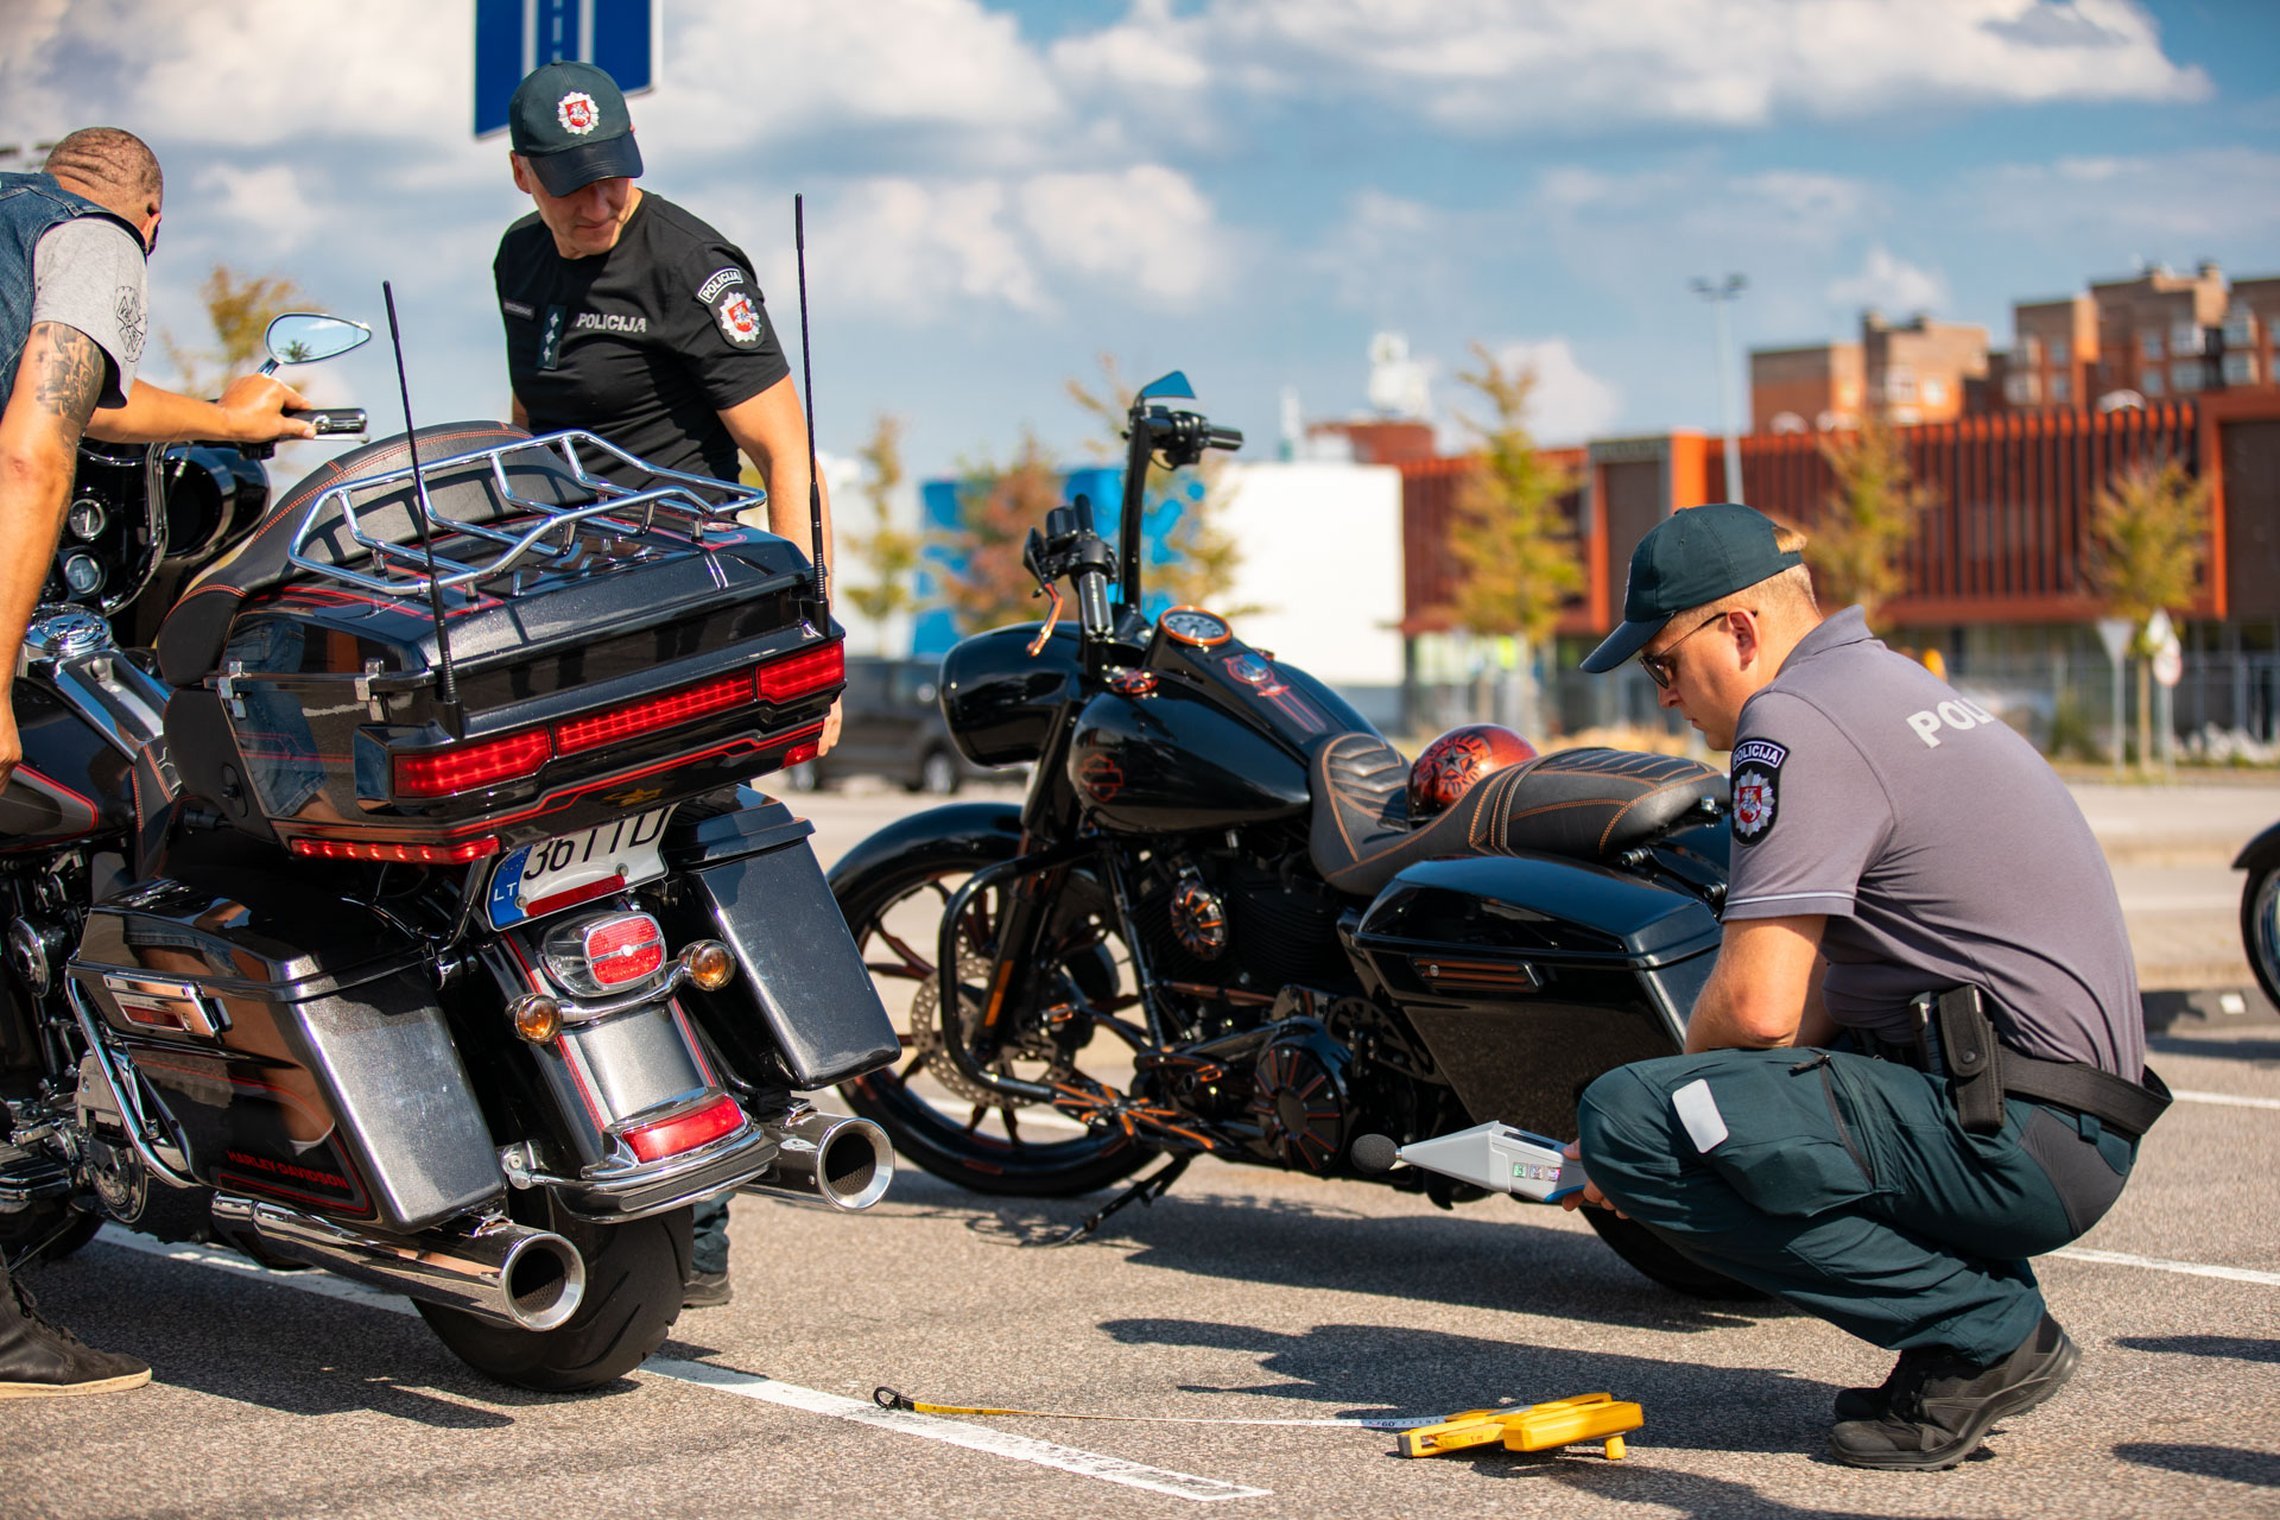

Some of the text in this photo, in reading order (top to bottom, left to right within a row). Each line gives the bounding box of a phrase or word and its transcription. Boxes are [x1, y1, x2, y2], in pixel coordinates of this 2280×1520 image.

[702, 271, 739, 299] POLICIJA
[576, 312, 647, 333] POLICIJA
[1733, 744, 1779, 766] POLICIJA
[493, 881, 517, 903] LT
[226, 1150, 349, 1189] HARLEY-DAVIDSON
